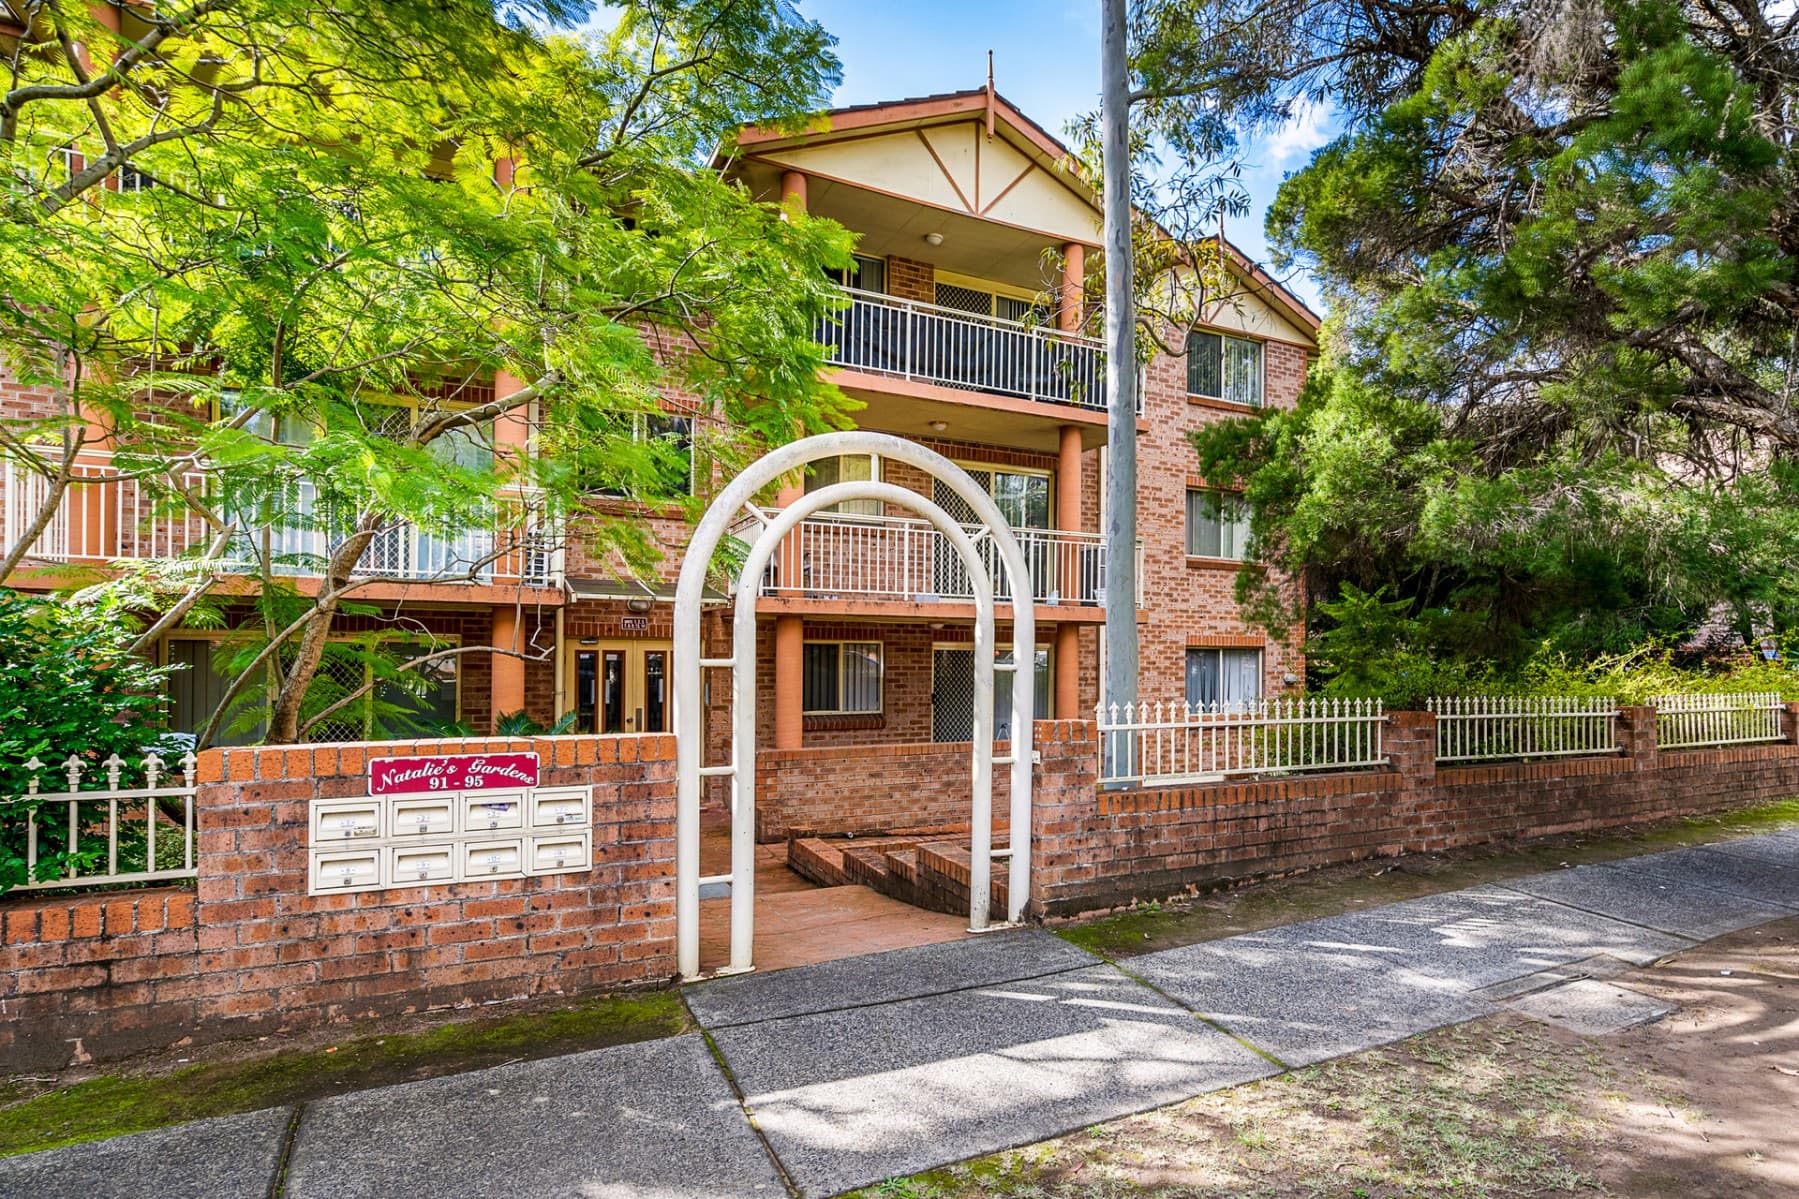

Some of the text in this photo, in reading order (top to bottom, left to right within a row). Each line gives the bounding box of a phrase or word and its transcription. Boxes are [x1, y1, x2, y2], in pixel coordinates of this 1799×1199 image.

[377, 759, 535, 791] Natalie's Gardens
[429, 776, 449, 790] 91
[464, 775, 484, 788] 95
